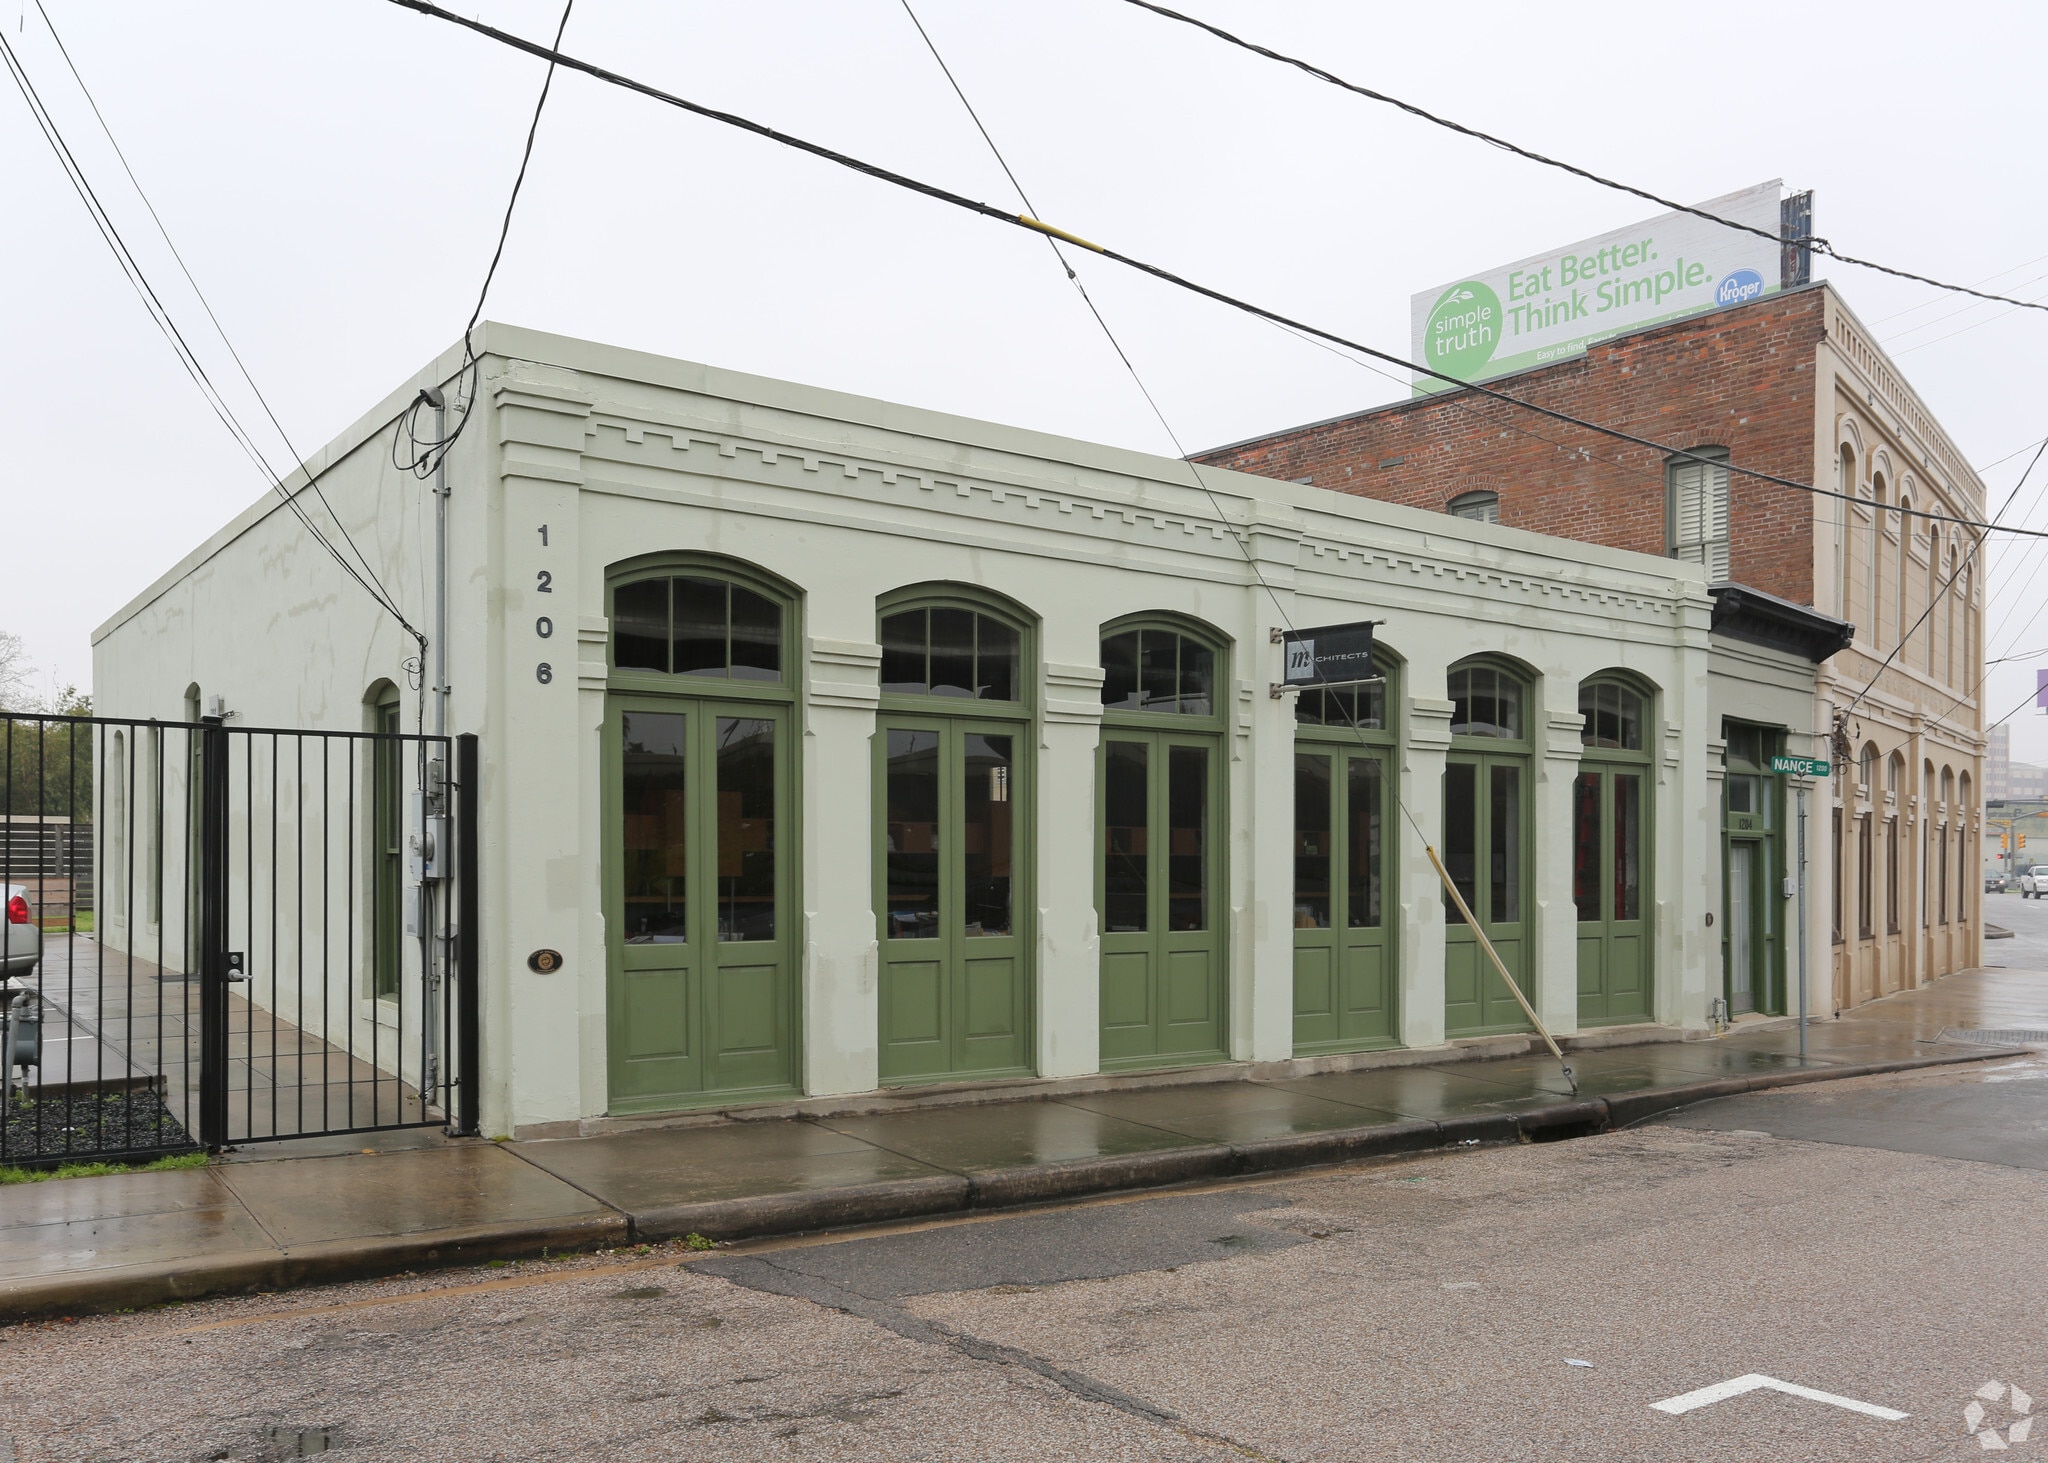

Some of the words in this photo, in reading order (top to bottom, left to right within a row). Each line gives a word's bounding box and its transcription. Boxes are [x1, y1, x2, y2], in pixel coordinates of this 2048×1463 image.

[1508, 265, 1552, 301] Eat
[1560, 237, 1658, 287] Better.
[1507, 288, 1589, 336] Think
[1596, 257, 1713, 313] Simple.
[1720, 278, 1760, 303] Kroger
[1435, 305, 1491, 334] simple
[1435, 323, 1491, 356] truth
[1537, 349, 1556, 360] Easy
[1557, 346, 1566, 354] to
[1305, 650, 1369, 664] CHITECTS
[1774, 758, 1813, 774] NANCE
